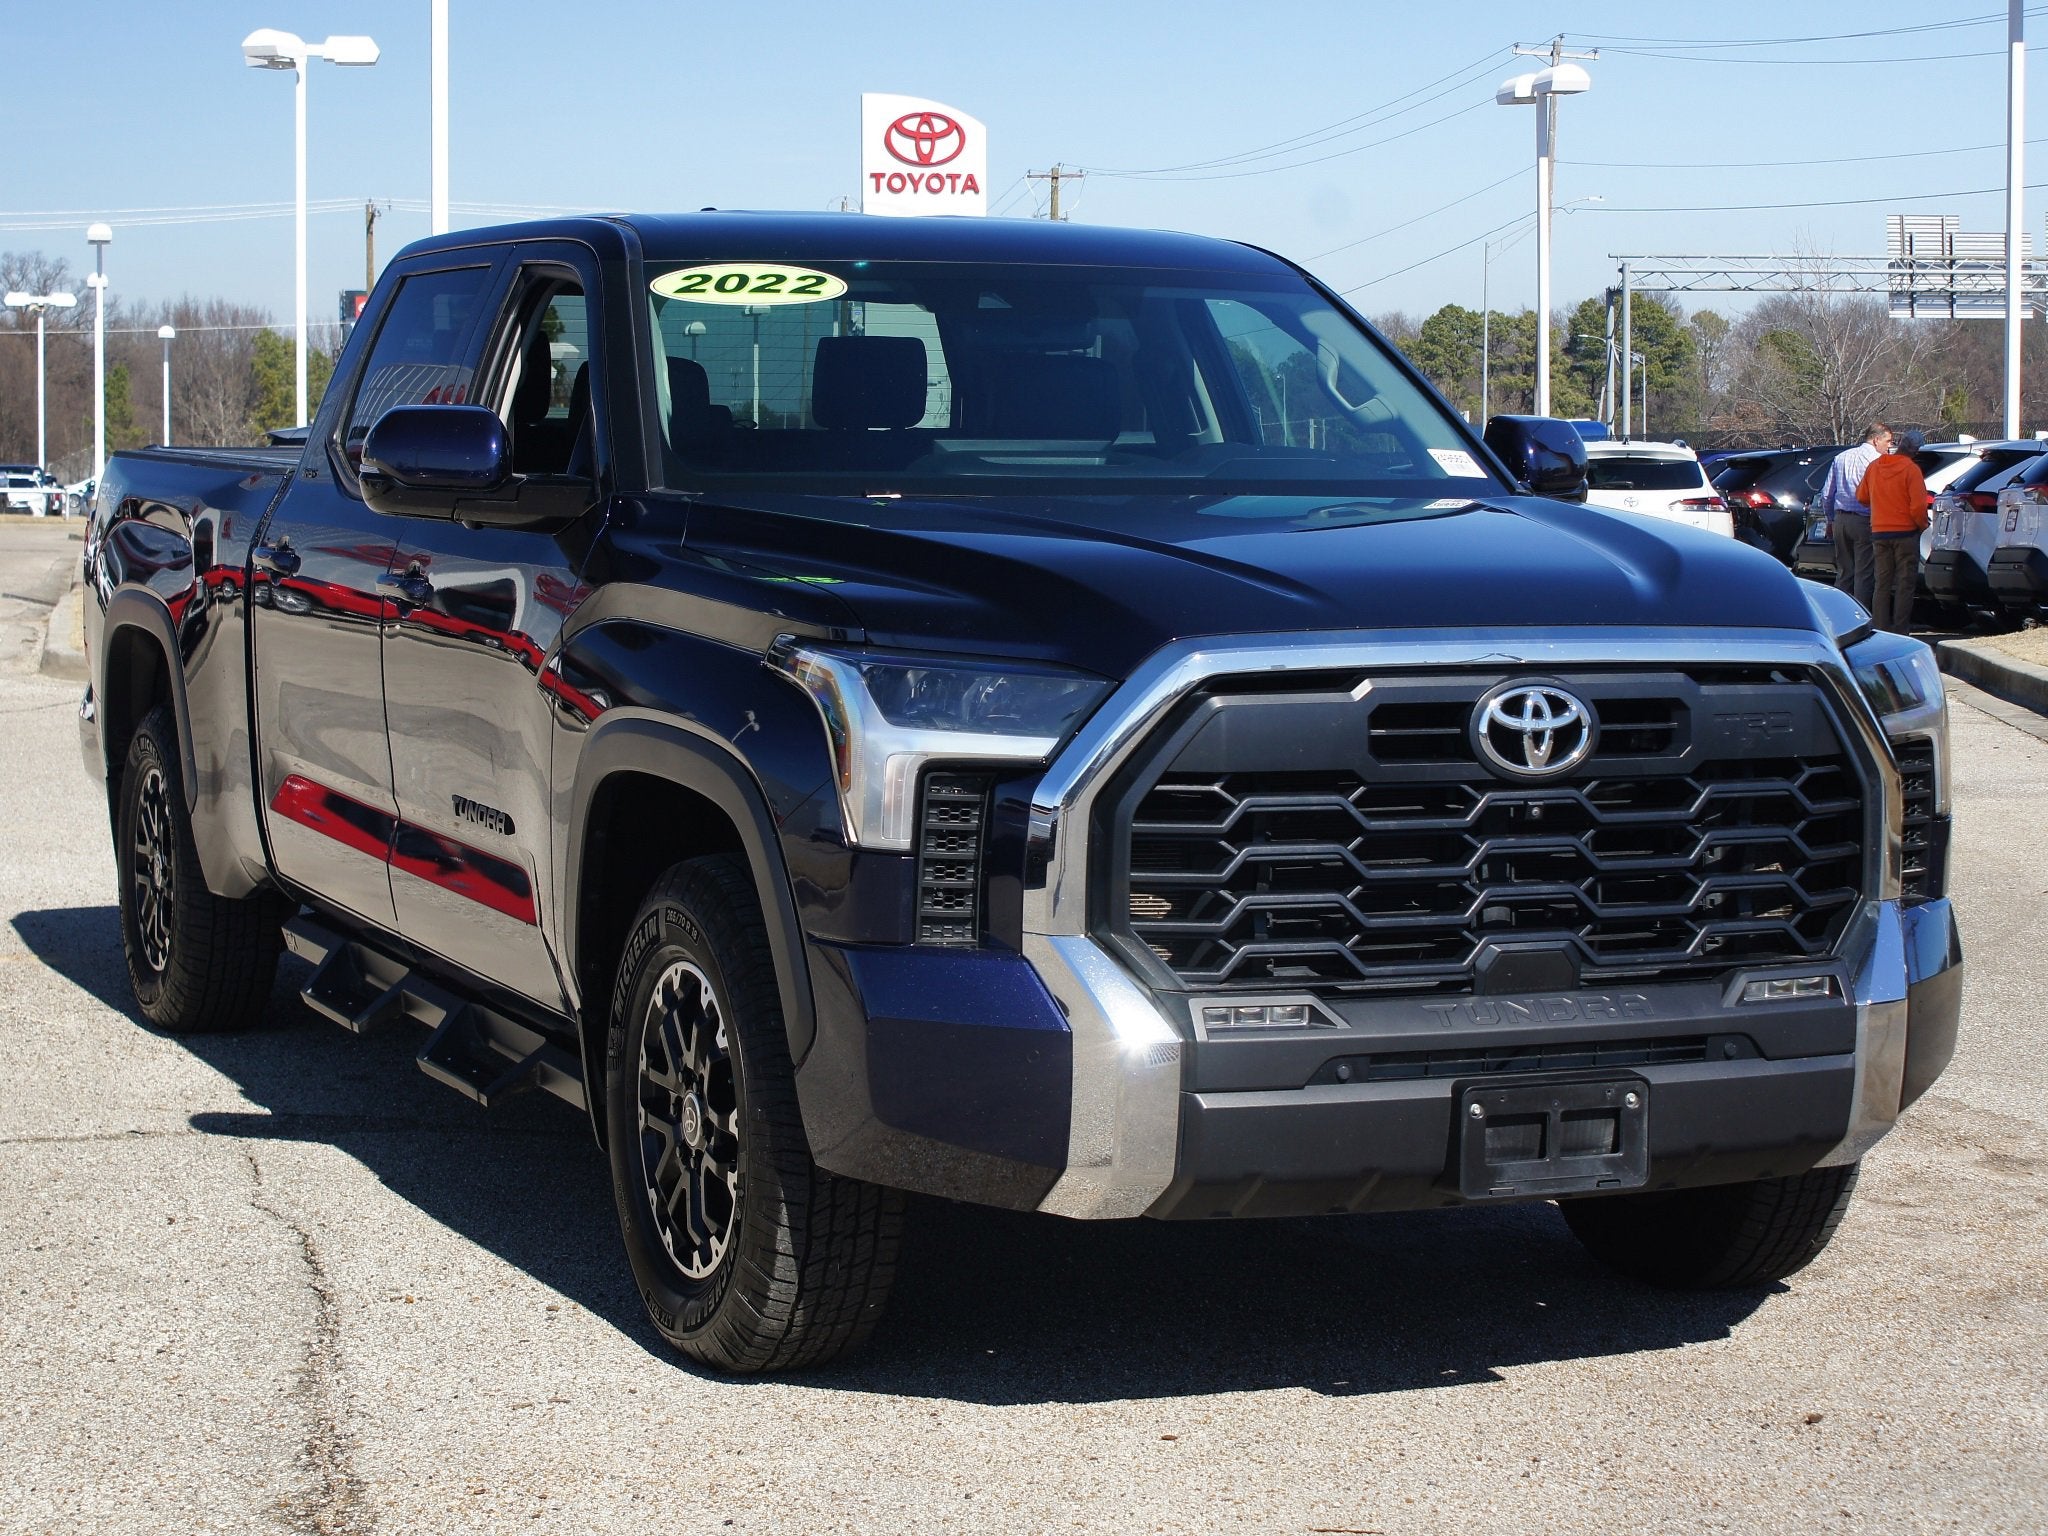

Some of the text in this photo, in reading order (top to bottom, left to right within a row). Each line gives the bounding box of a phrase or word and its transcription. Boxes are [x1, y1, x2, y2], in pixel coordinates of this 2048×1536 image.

[869, 172, 980, 194] TOYOTA
[673, 273, 828, 294] 2022
[1712, 711, 1794, 740] TRD
[452, 794, 507, 835] TUNDRA
[666, 909, 686, 929] 265/70
[614, 915, 659, 1019] MICHELIN
[1422, 994, 1655, 1028] TUNDRA
